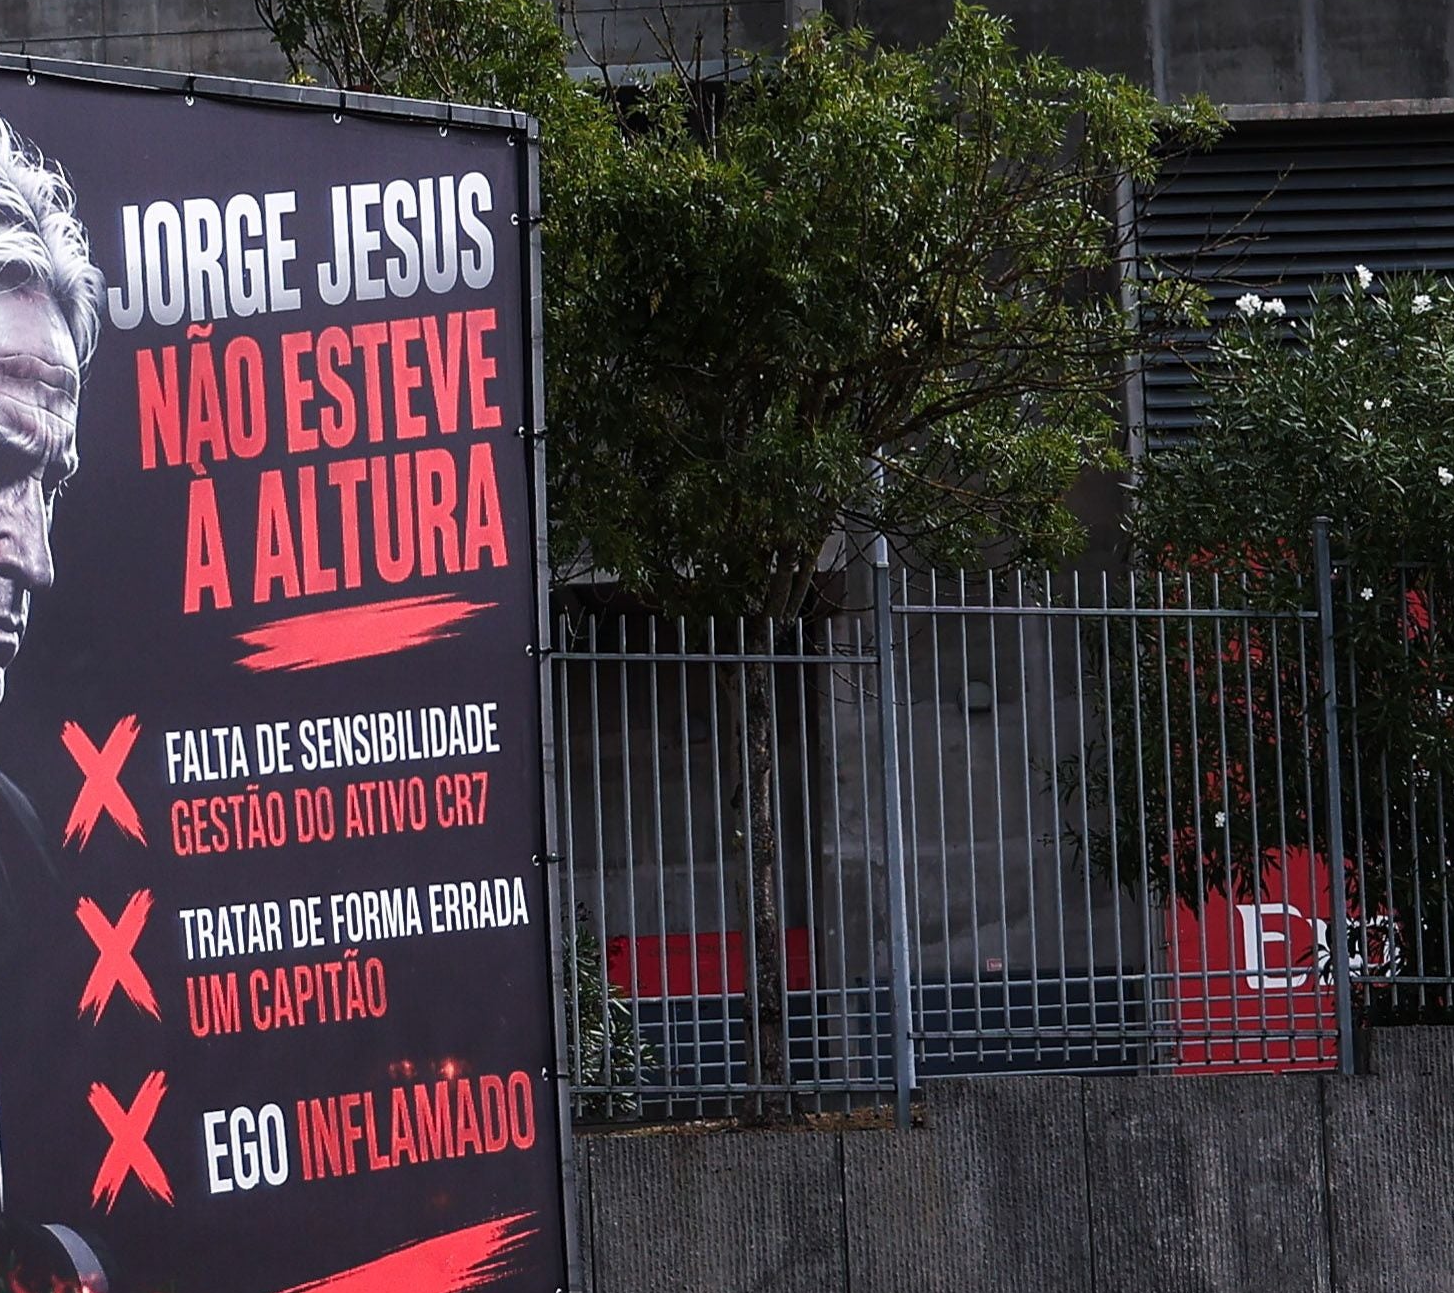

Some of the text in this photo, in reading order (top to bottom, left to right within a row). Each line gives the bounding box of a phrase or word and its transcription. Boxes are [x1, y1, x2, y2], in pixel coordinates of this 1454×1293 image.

[107, 171, 496, 329] JORGE JESUS
[136, 309, 502, 470] NÃO ESTEVE
[183, 442, 508, 614] À ALTURA
[165, 702, 500, 784] FALTA DE SENSIBILIDADE
[171, 771, 489, 856] GESTÃO DO ATIVO CR7
[179, 877, 529, 960] TRATAR DE FORMA ERRADA
[186, 949, 387, 1038] UM CAPITÃO
[203, 1071, 536, 1193] EGO INFLAMADO
